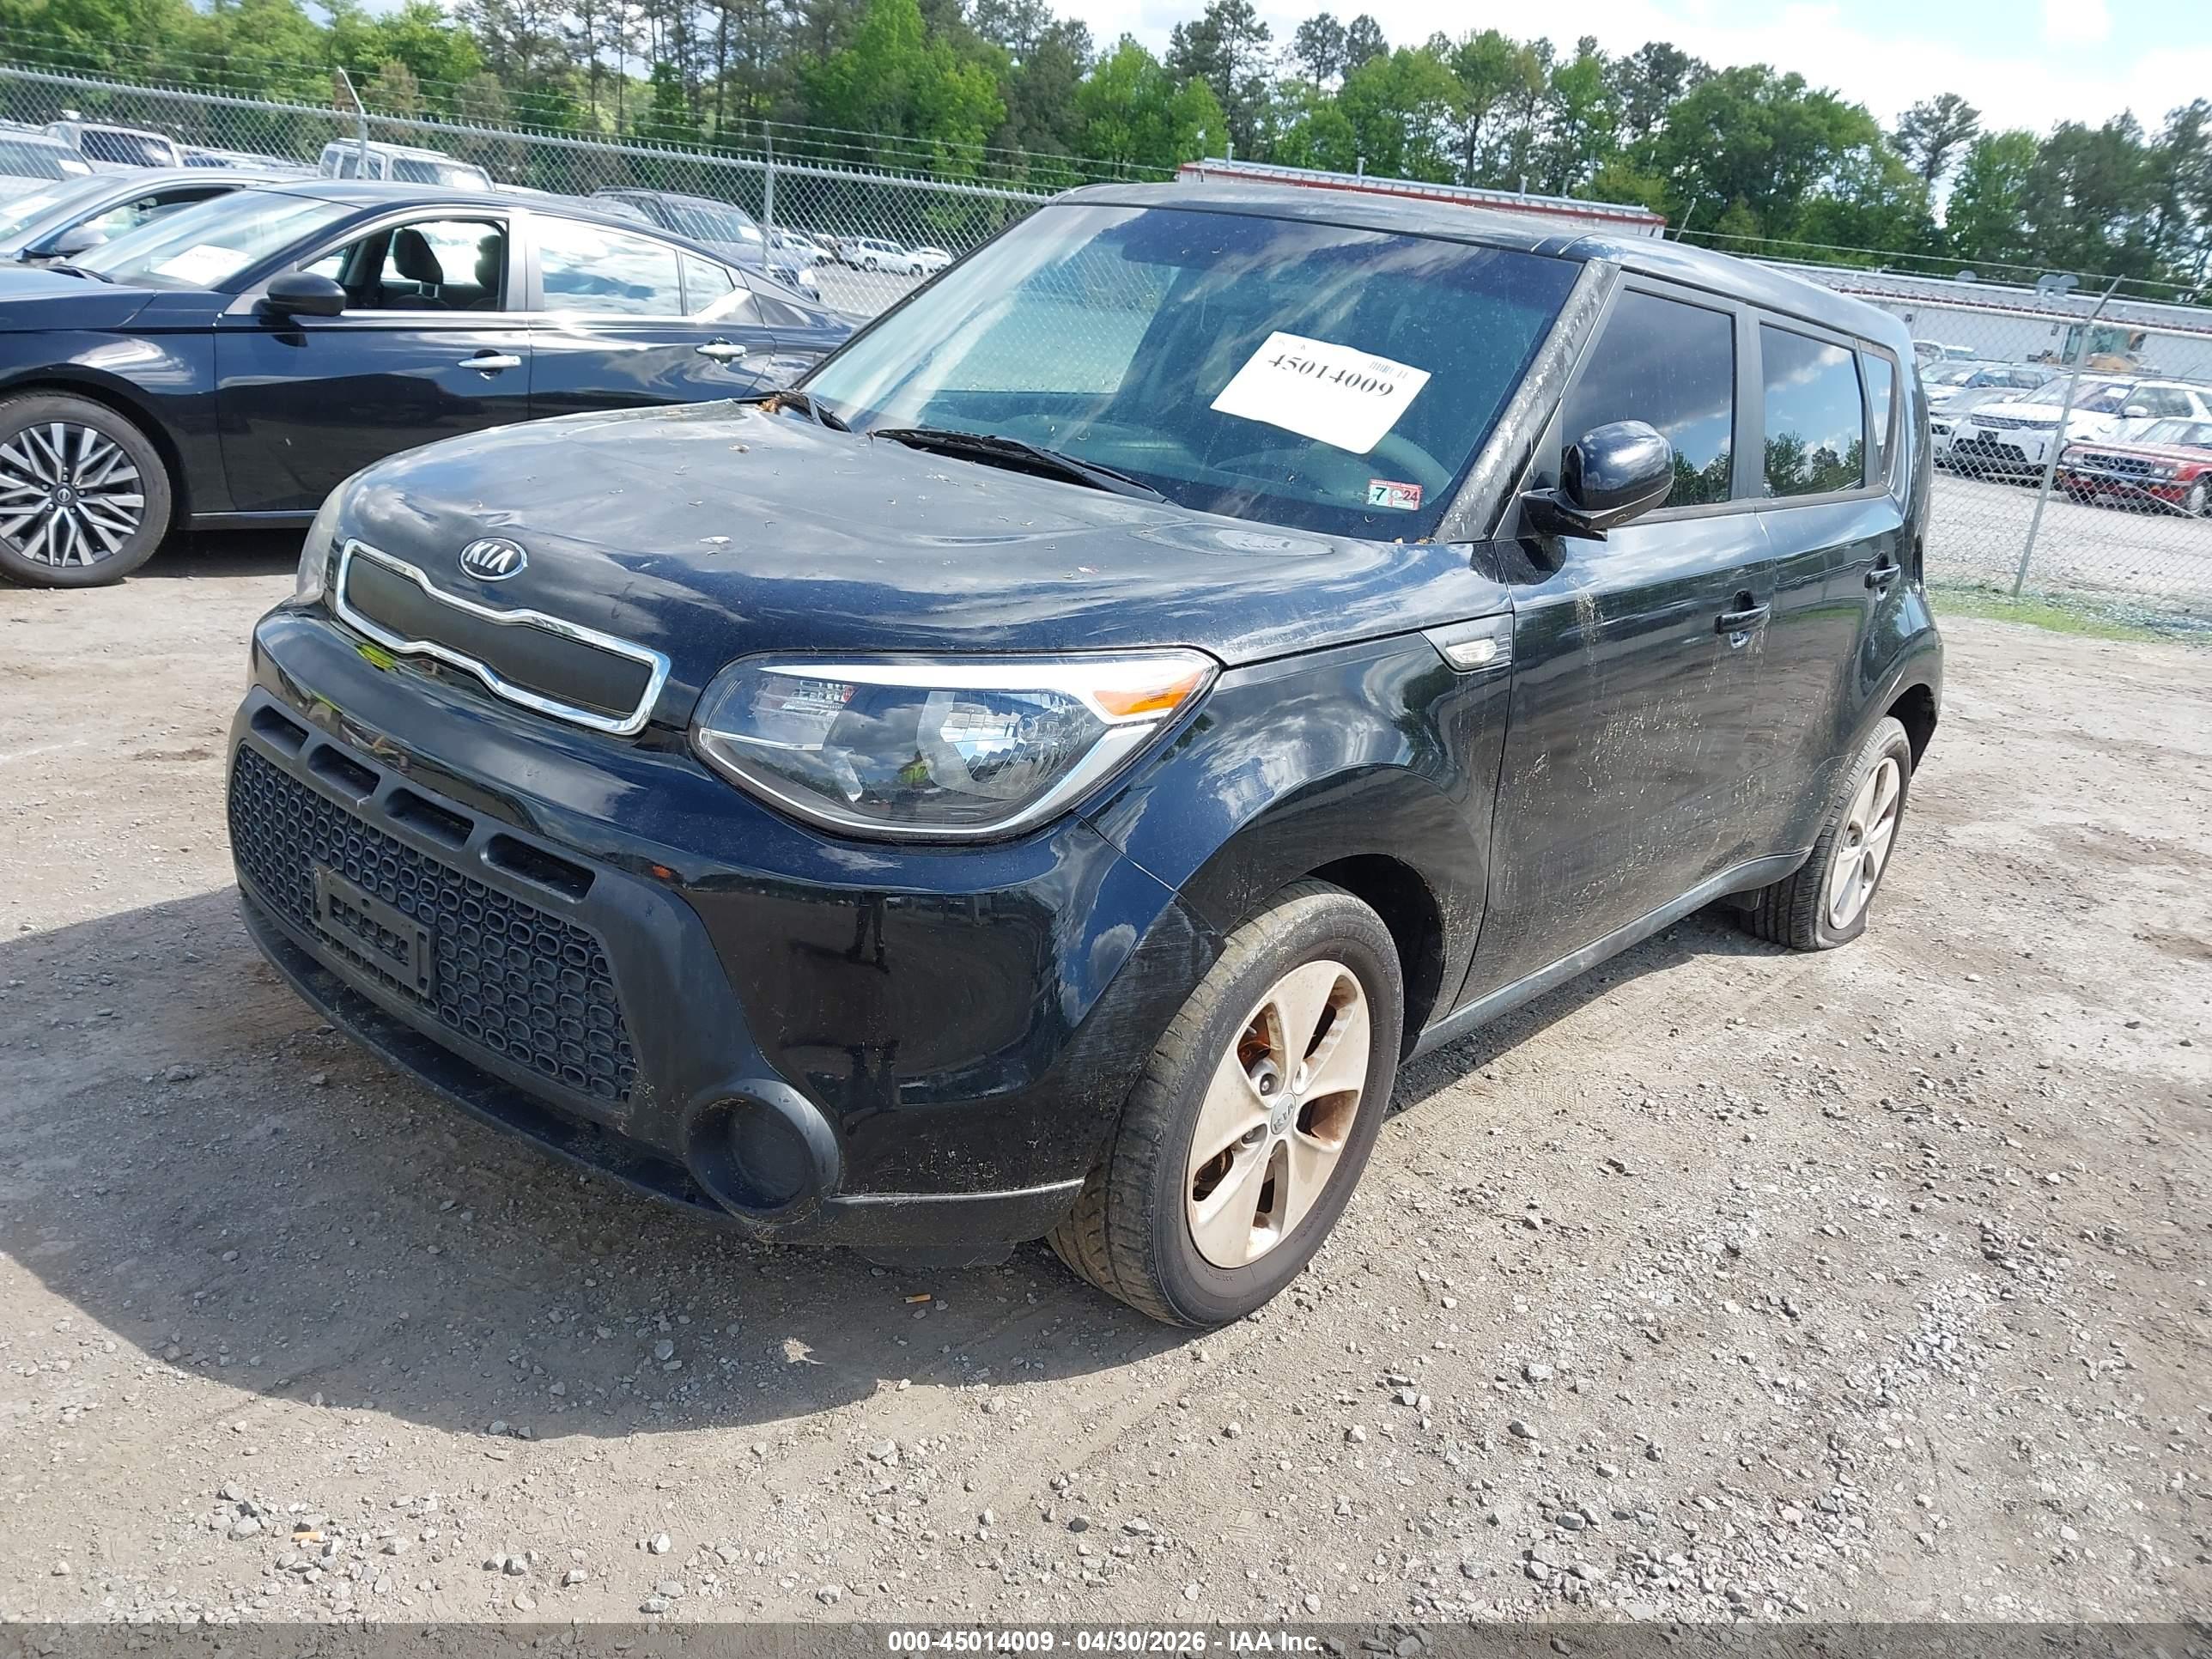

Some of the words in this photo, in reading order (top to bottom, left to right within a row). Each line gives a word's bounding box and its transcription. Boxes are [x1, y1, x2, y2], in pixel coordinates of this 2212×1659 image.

[1267, 354, 1395, 397] 45014009
[1376, 487, 1387, 501] 7
[1402, 489, 1418, 502] 24
[465, 541, 514, 574] KIA
